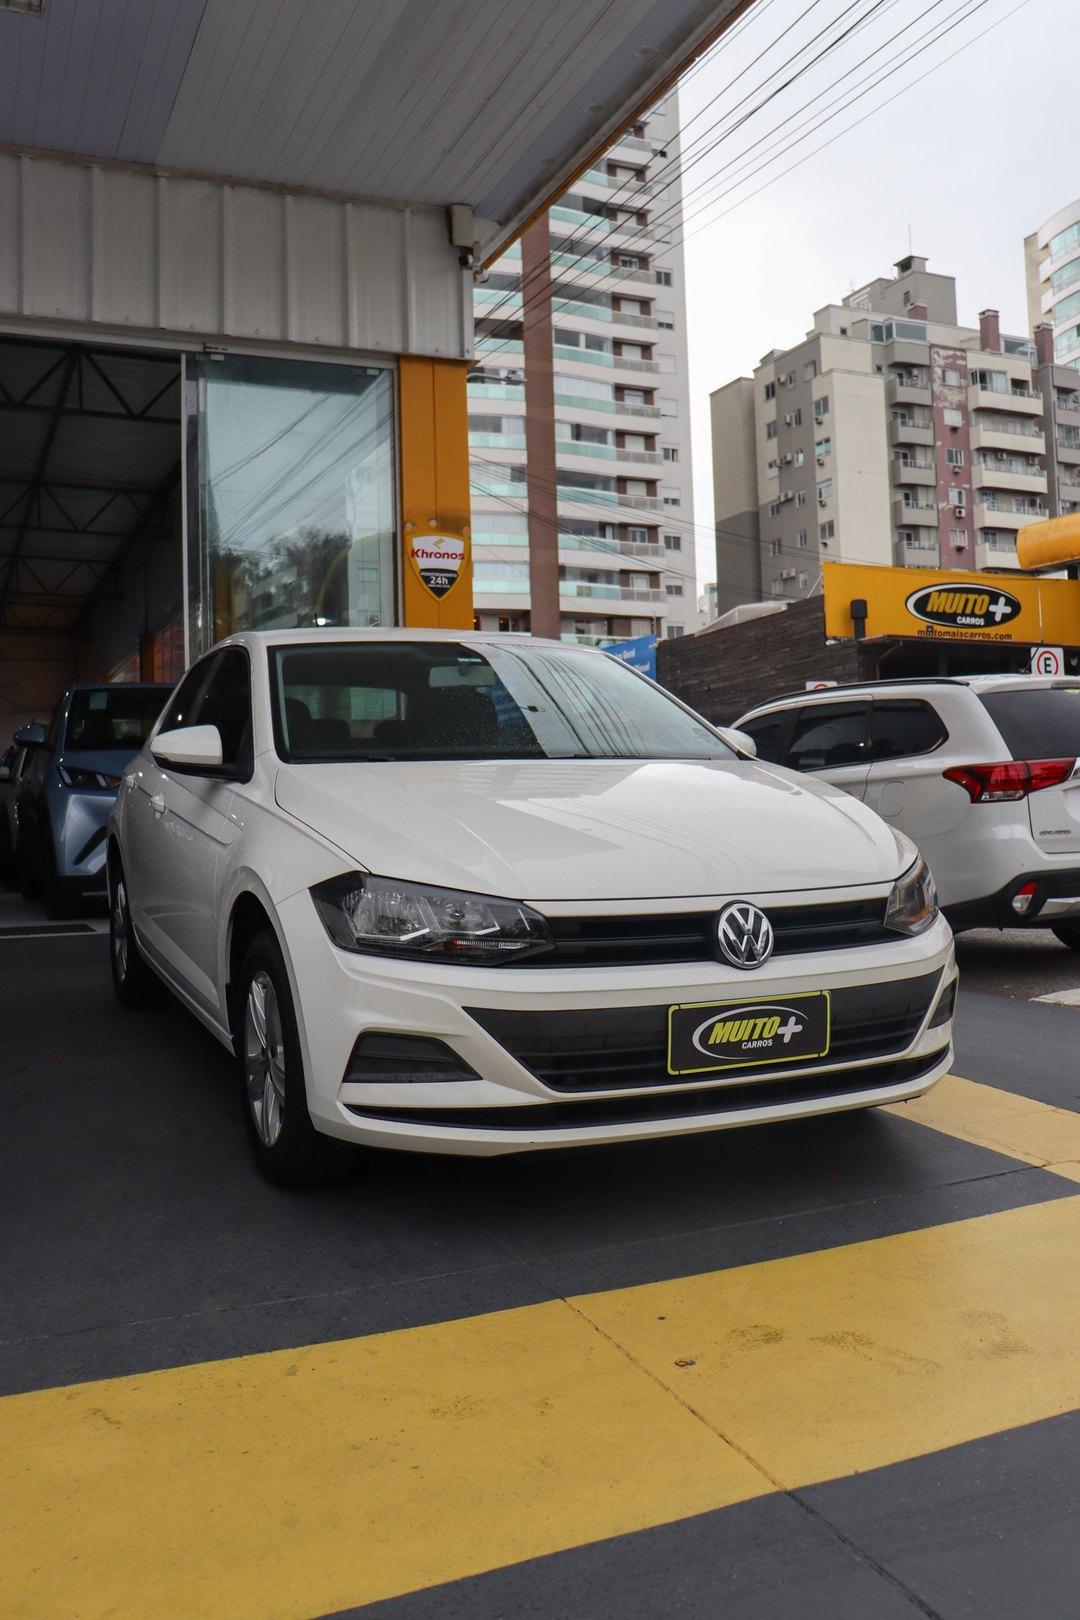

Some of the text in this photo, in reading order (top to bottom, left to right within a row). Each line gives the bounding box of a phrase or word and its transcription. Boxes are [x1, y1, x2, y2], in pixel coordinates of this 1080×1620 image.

[411, 548, 465, 560] Khronos
[430, 576, 448, 584] 24h
[956, 616, 984, 625] CARROS
[1044, 657, 1052, 673] E
[742, 1039, 773, 1050] CARROS
